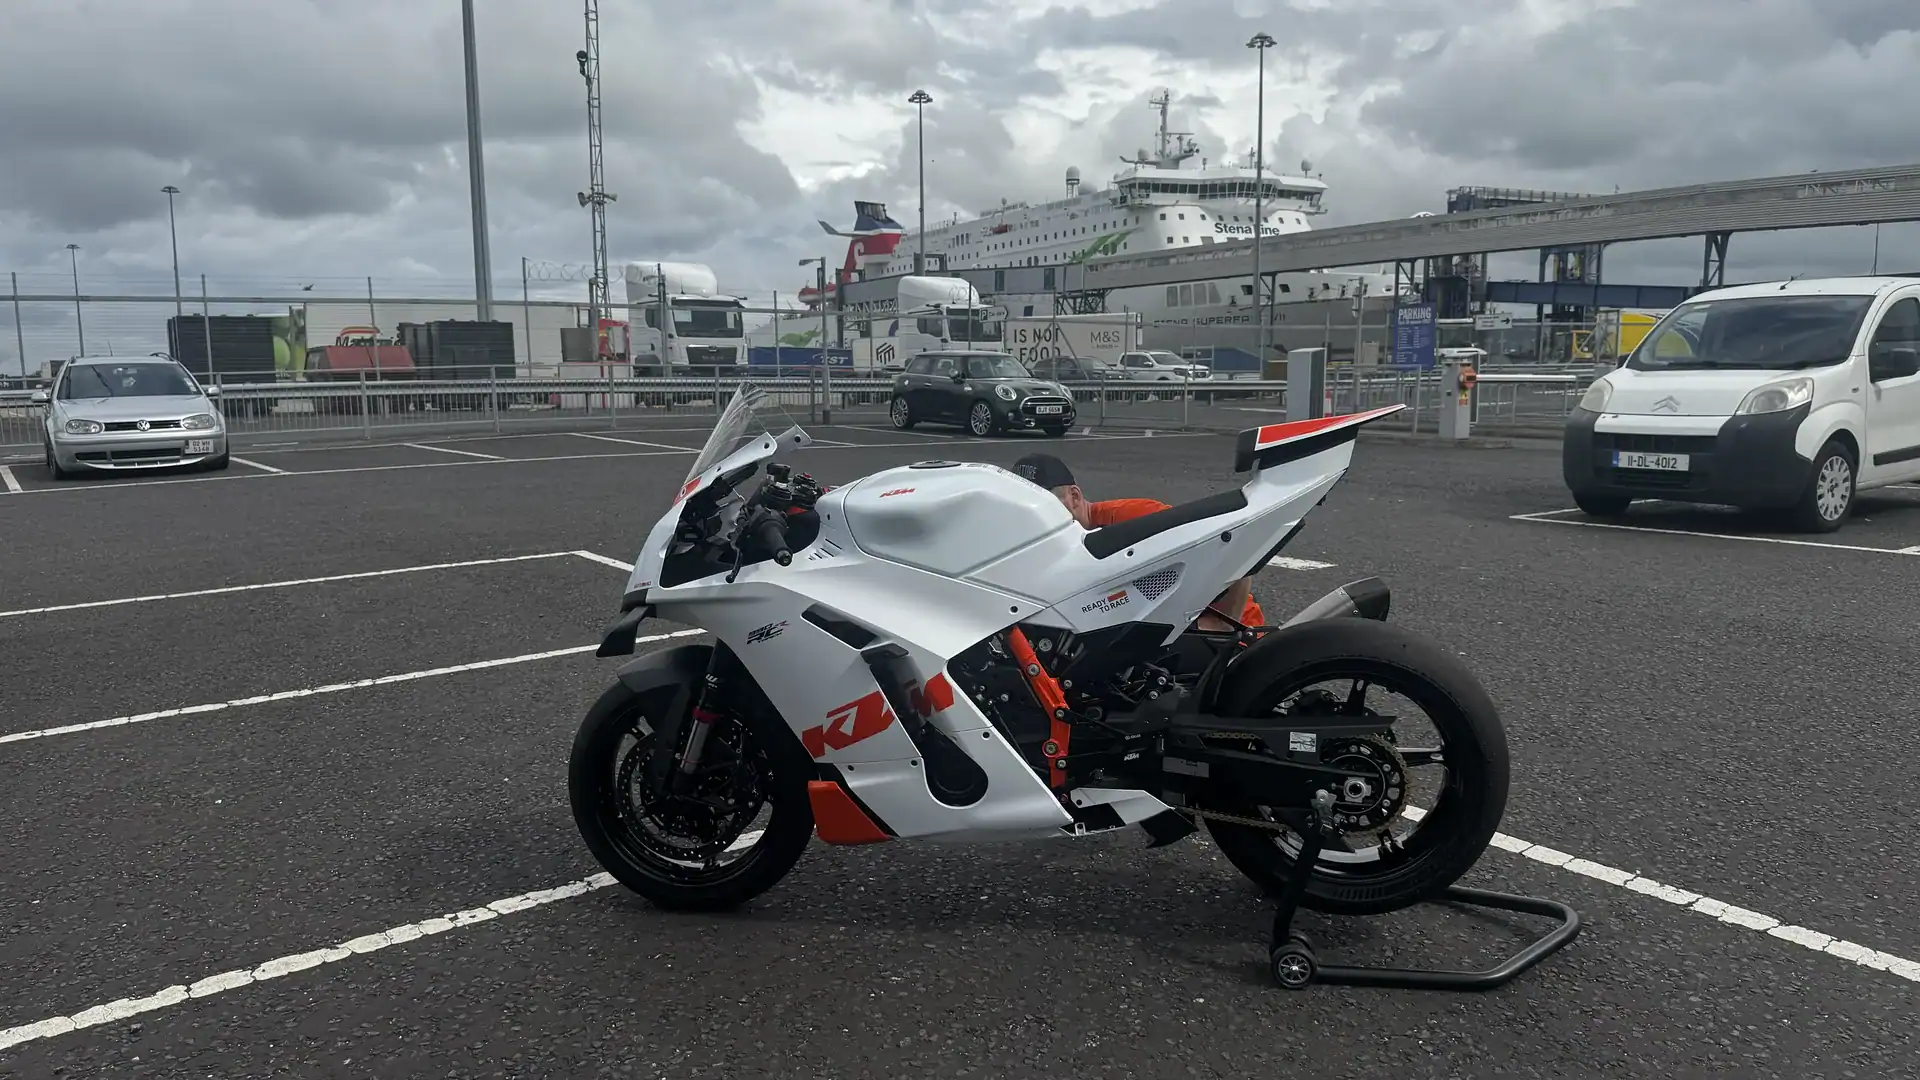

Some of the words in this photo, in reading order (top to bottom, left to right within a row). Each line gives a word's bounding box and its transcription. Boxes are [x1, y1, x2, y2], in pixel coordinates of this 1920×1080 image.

[1214, 222, 1252, 234] Stena
[1254, 223, 1280, 236] ine
[1398, 306, 1432, 320] PARKING
[1194, 315, 1251, 326] SUPERFA
[1014, 328, 1027, 343] IS
[1090, 330, 1120, 343] M&S
[1627, 455, 1678, 469] 11-DL-4012
[880, 487, 916, 498] KTM
[1081, 598, 1106, 613] READY
[1099, 605, 1110, 613] TO
[1109, 595, 1130, 610] RACE
[802, 672, 954, 759] KTM
[1123, 752, 1140, 761] KTM
